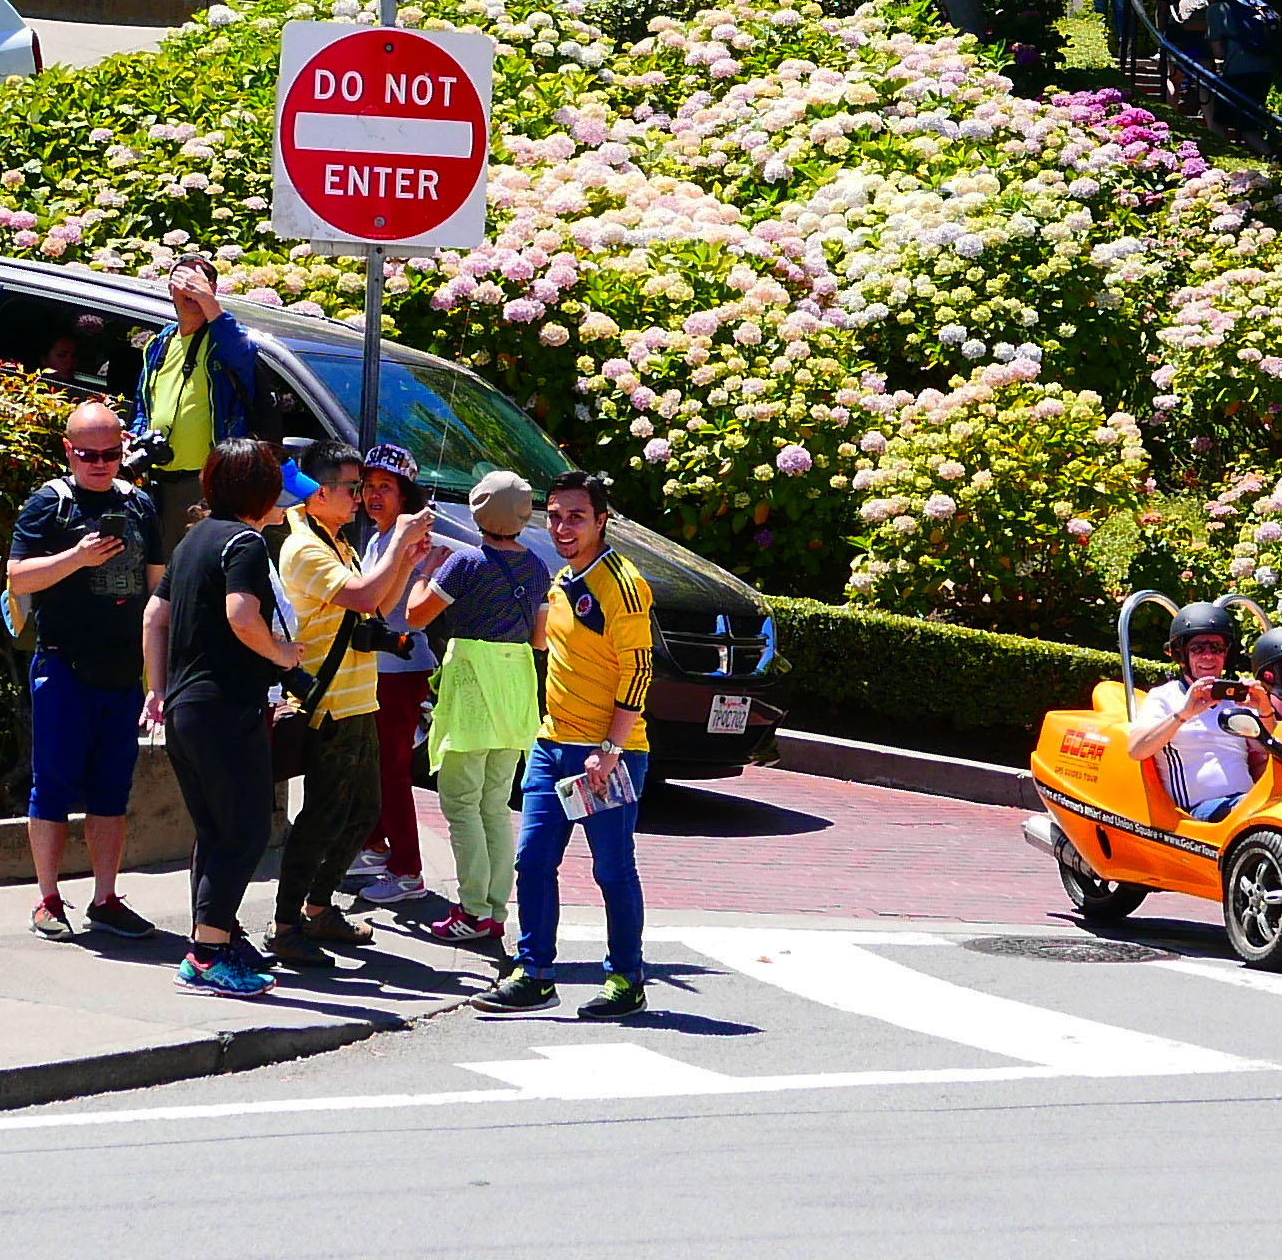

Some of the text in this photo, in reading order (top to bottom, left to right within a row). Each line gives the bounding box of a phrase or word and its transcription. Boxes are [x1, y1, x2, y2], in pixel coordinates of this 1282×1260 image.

[314, 69, 458, 107] DO NOT
[323, 164, 440, 201] ENTER
[1083, 773, 1099, 783] TOUR
[1084, 803, 1103, 821] Wharf
[1102, 810, 1115, 824] and
[1114, 814, 1134, 831] Union
[1134, 823, 1158, 840] Square
